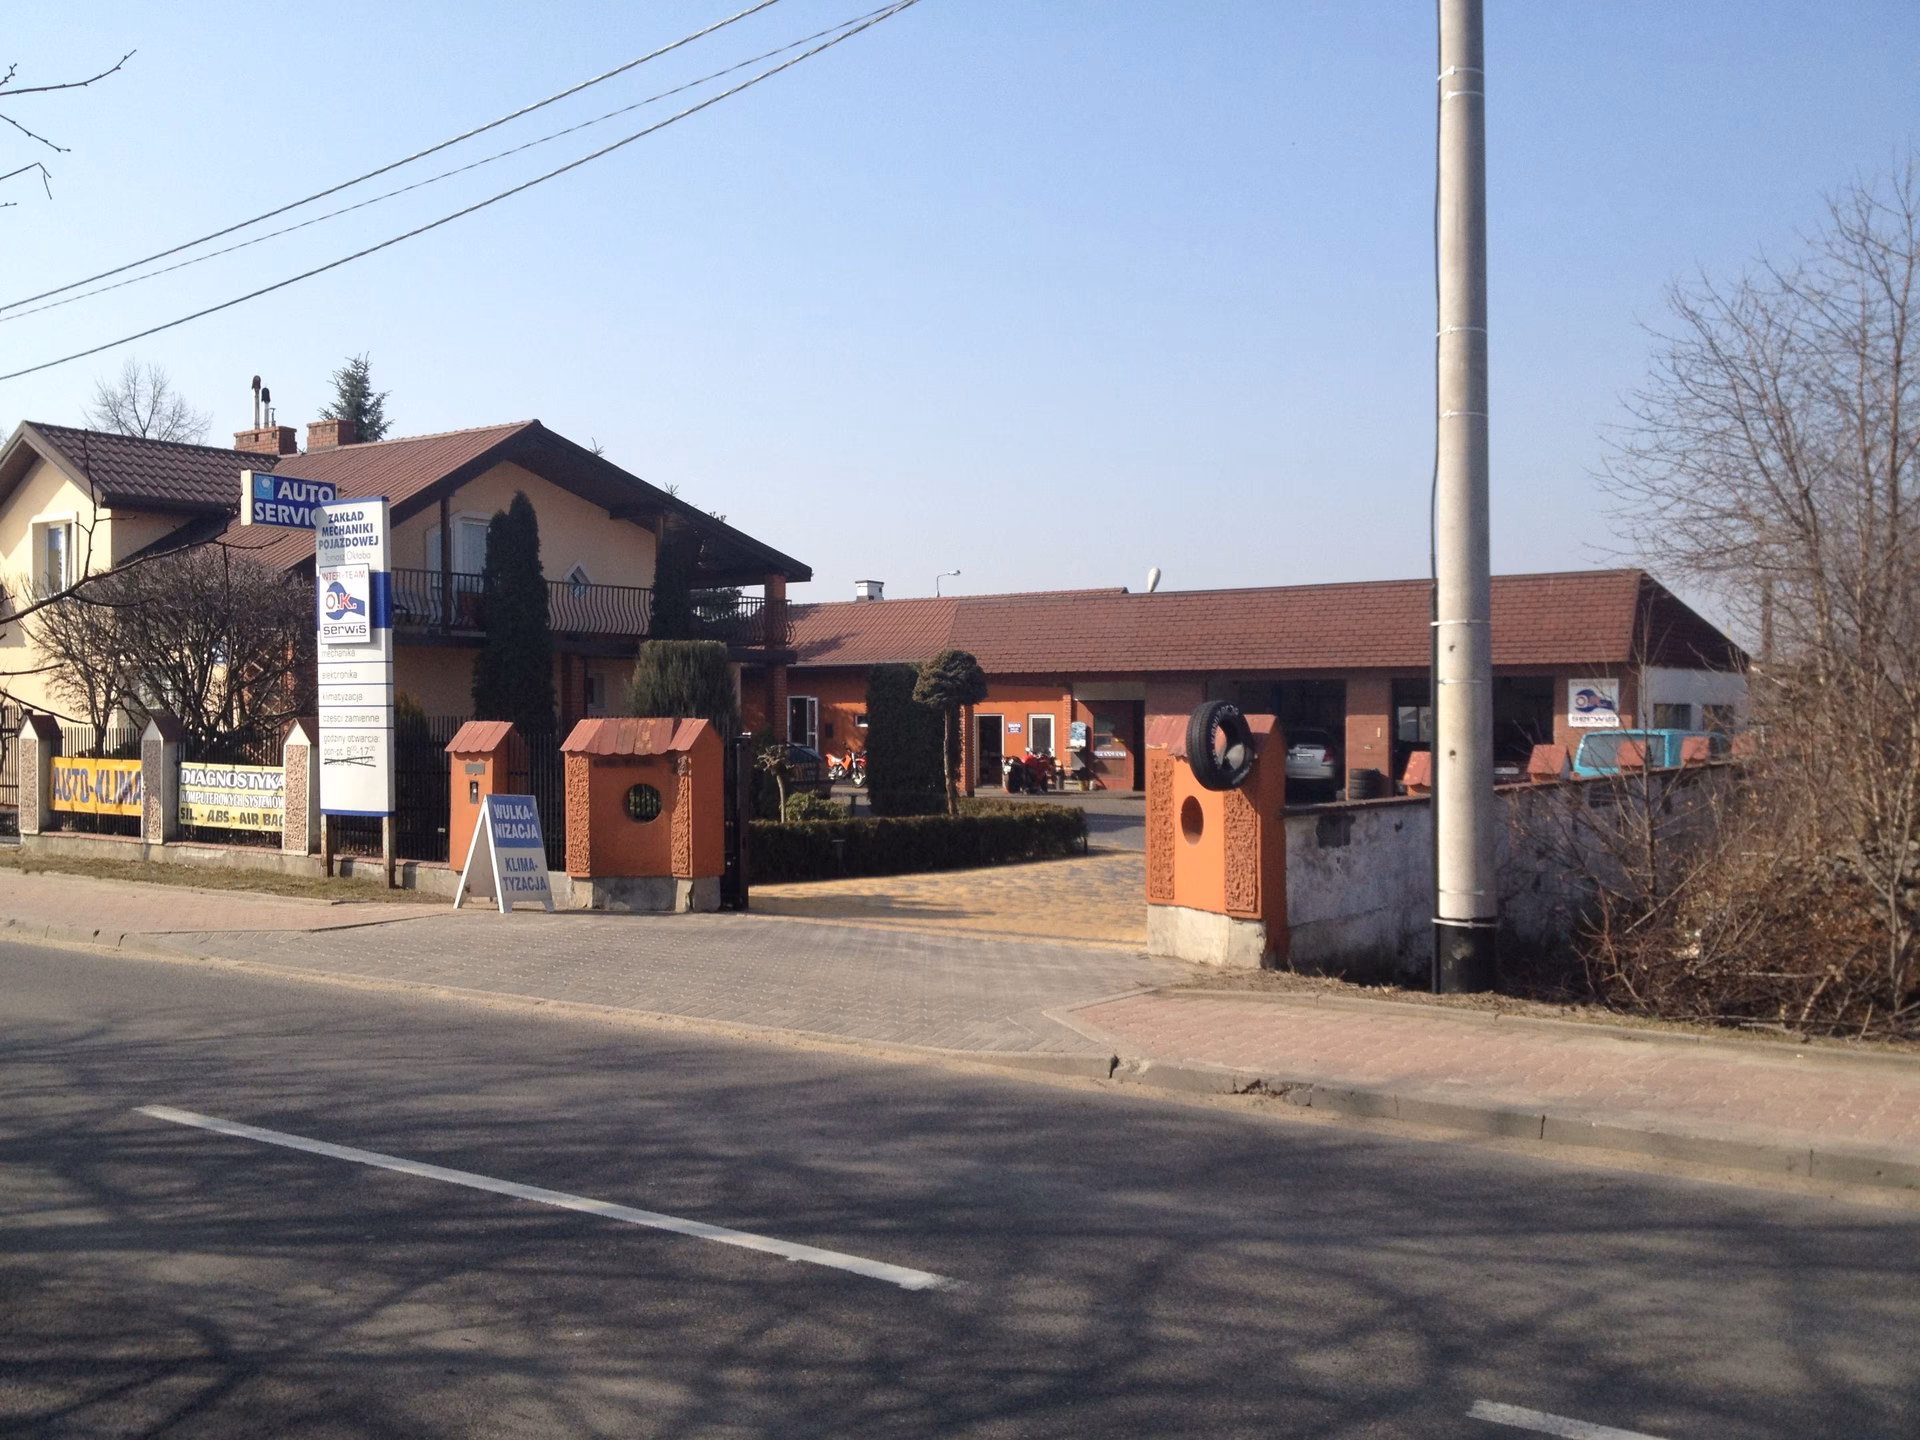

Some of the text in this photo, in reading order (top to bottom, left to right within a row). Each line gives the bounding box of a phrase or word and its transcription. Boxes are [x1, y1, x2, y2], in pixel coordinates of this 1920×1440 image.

[277, 481, 334, 503] AUTO
[328, 511, 364, 524] ZAKŁAD
[322, 523, 373, 537] MECHANIKI
[318, 535, 379, 550] POJAZDOWEJ
[323, 624, 366, 635] serwis
[322, 692, 363, 703] klimatyzacja
[344, 714, 380, 723] zamienne
[180, 768, 284, 790] DIAGNOSTYKA
[181, 790, 244, 807] KOMPUTEROWYCH
[207, 810, 230, 823] ABS
[239, 812, 259, 825] AIR
[495, 823, 538, 839] NIZACJA
[502, 876, 547, 891] TYZACJA
